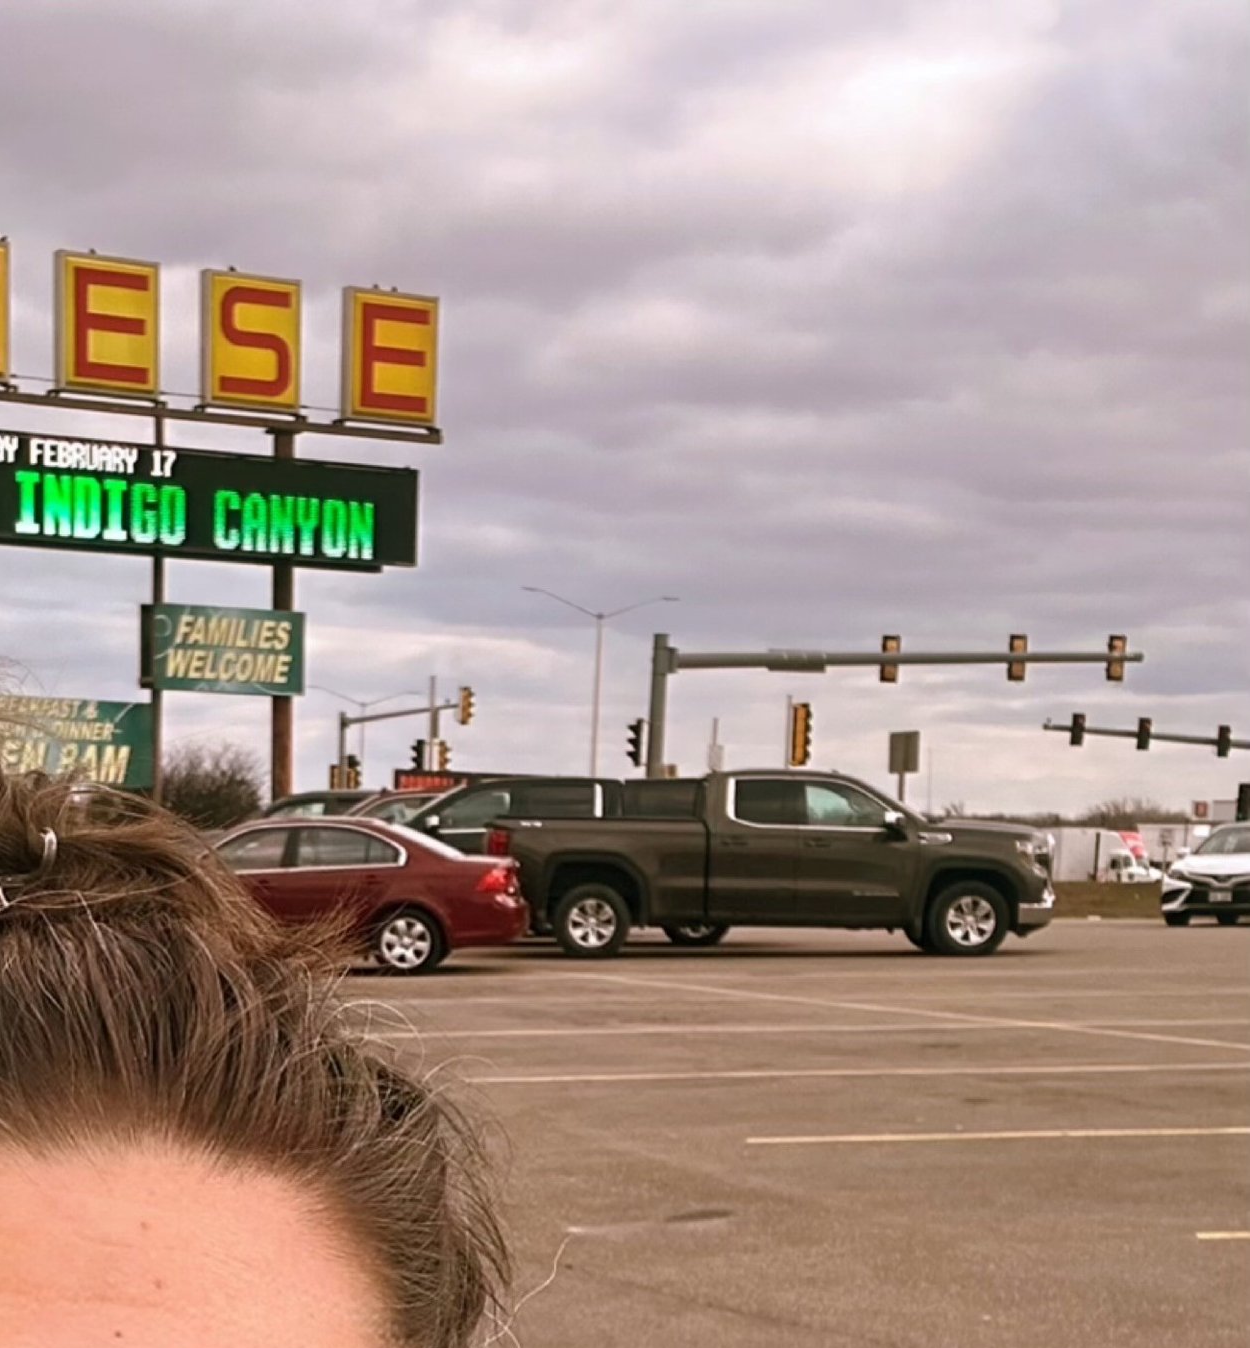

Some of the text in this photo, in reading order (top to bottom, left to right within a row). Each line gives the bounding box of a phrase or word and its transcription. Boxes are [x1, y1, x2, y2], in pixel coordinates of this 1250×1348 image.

[30, 437, 138, 474] FEBRUARY
[150, 449, 177, 477] 17
[15, 470, 186, 546] INDIGO
[213, 489, 375, 560] CANYON
[174, 614, 293, 650] FAMILIES
[166, 648, 293, 684] WELCOME
